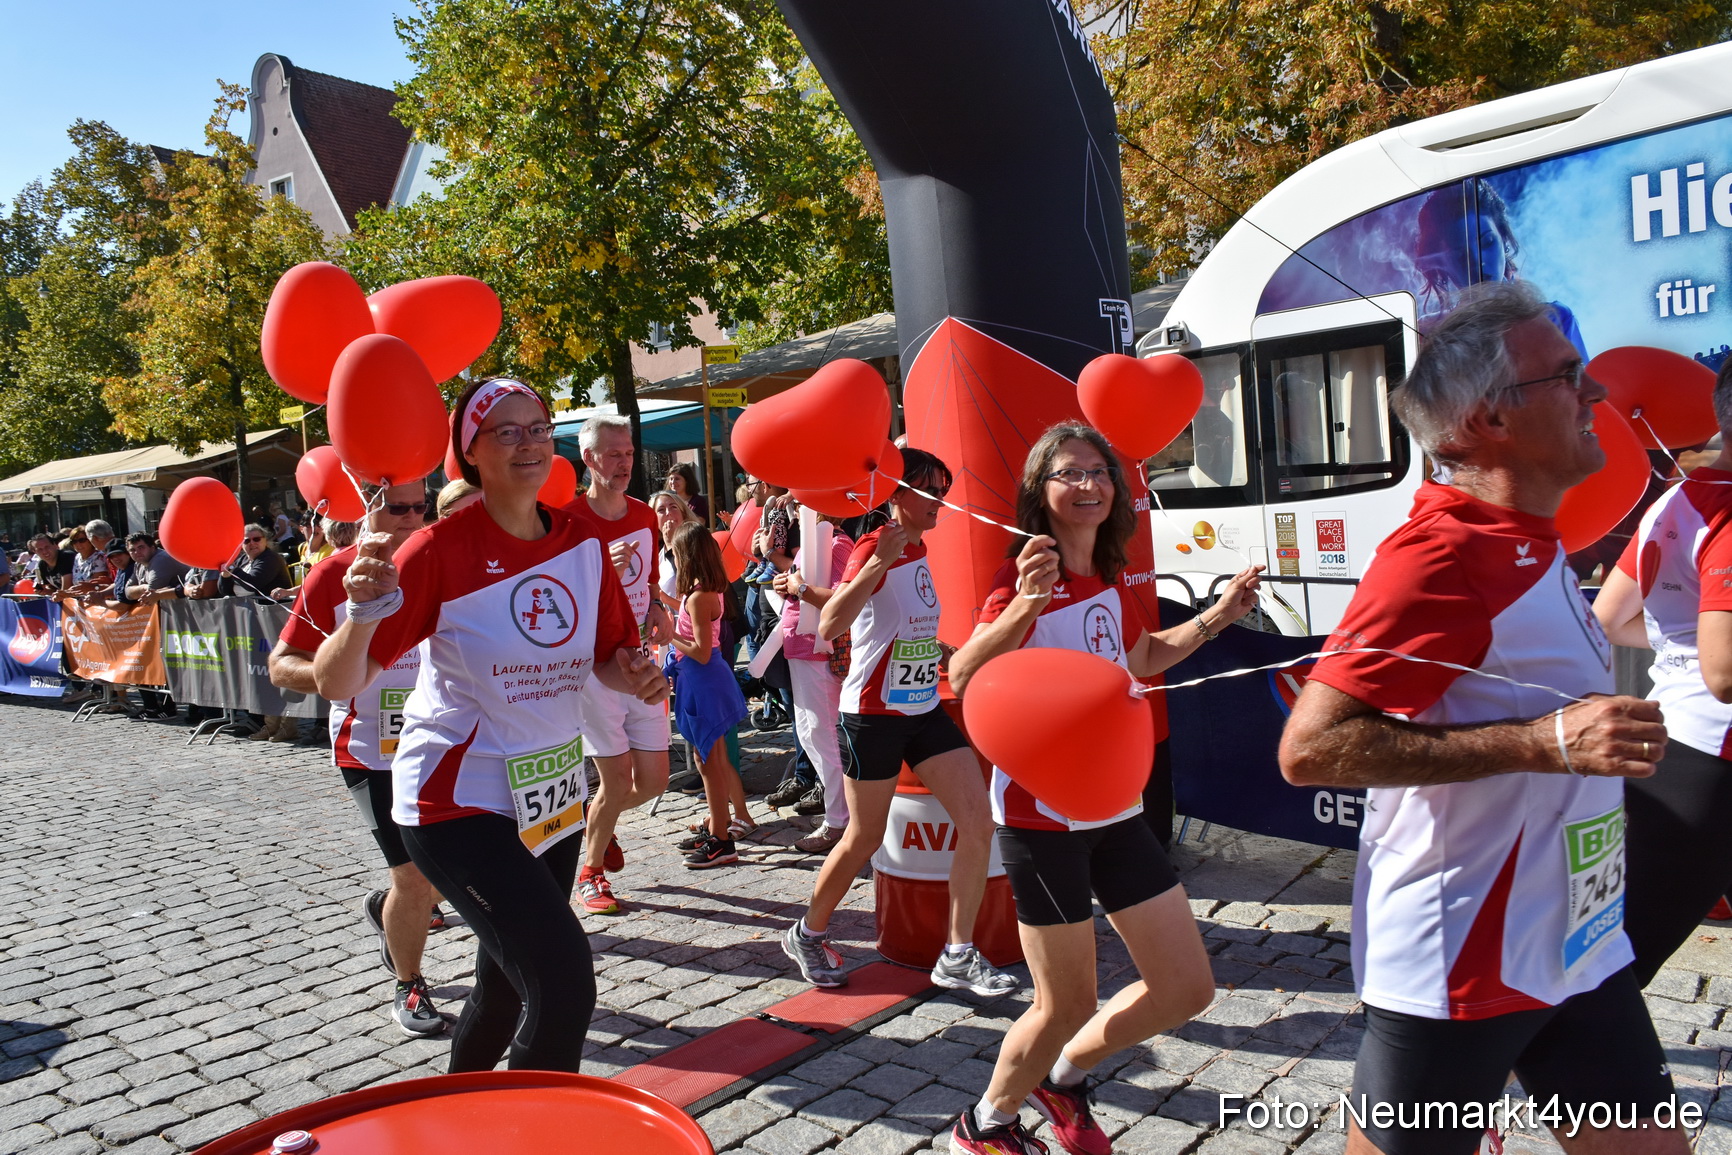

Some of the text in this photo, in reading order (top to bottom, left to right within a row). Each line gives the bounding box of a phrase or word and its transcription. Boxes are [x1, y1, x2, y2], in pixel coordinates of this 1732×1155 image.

[1656, 279, 1716, 318] für
[1277, 515, 1293, 523] TOP
[1278, 532, 1296, 541] 2018
[1320, 554, 1345, 564] 2018
[493, 664, 541, 677] LAUFEN
[547, 661, 567, 672] MIT
[504, 681, 516, 690] Dr.
[517, 678, 540, 687] Heck
[908, 689, 933, 703] DORIS
[516, 743, 580, 785] BOCK
[524, 772, 577, 823] 5124
[543, 818, 561, 836] INA
[466, 885, 488, 906] CRAFT
[1583, 902, 1624, 947] JOSEF
